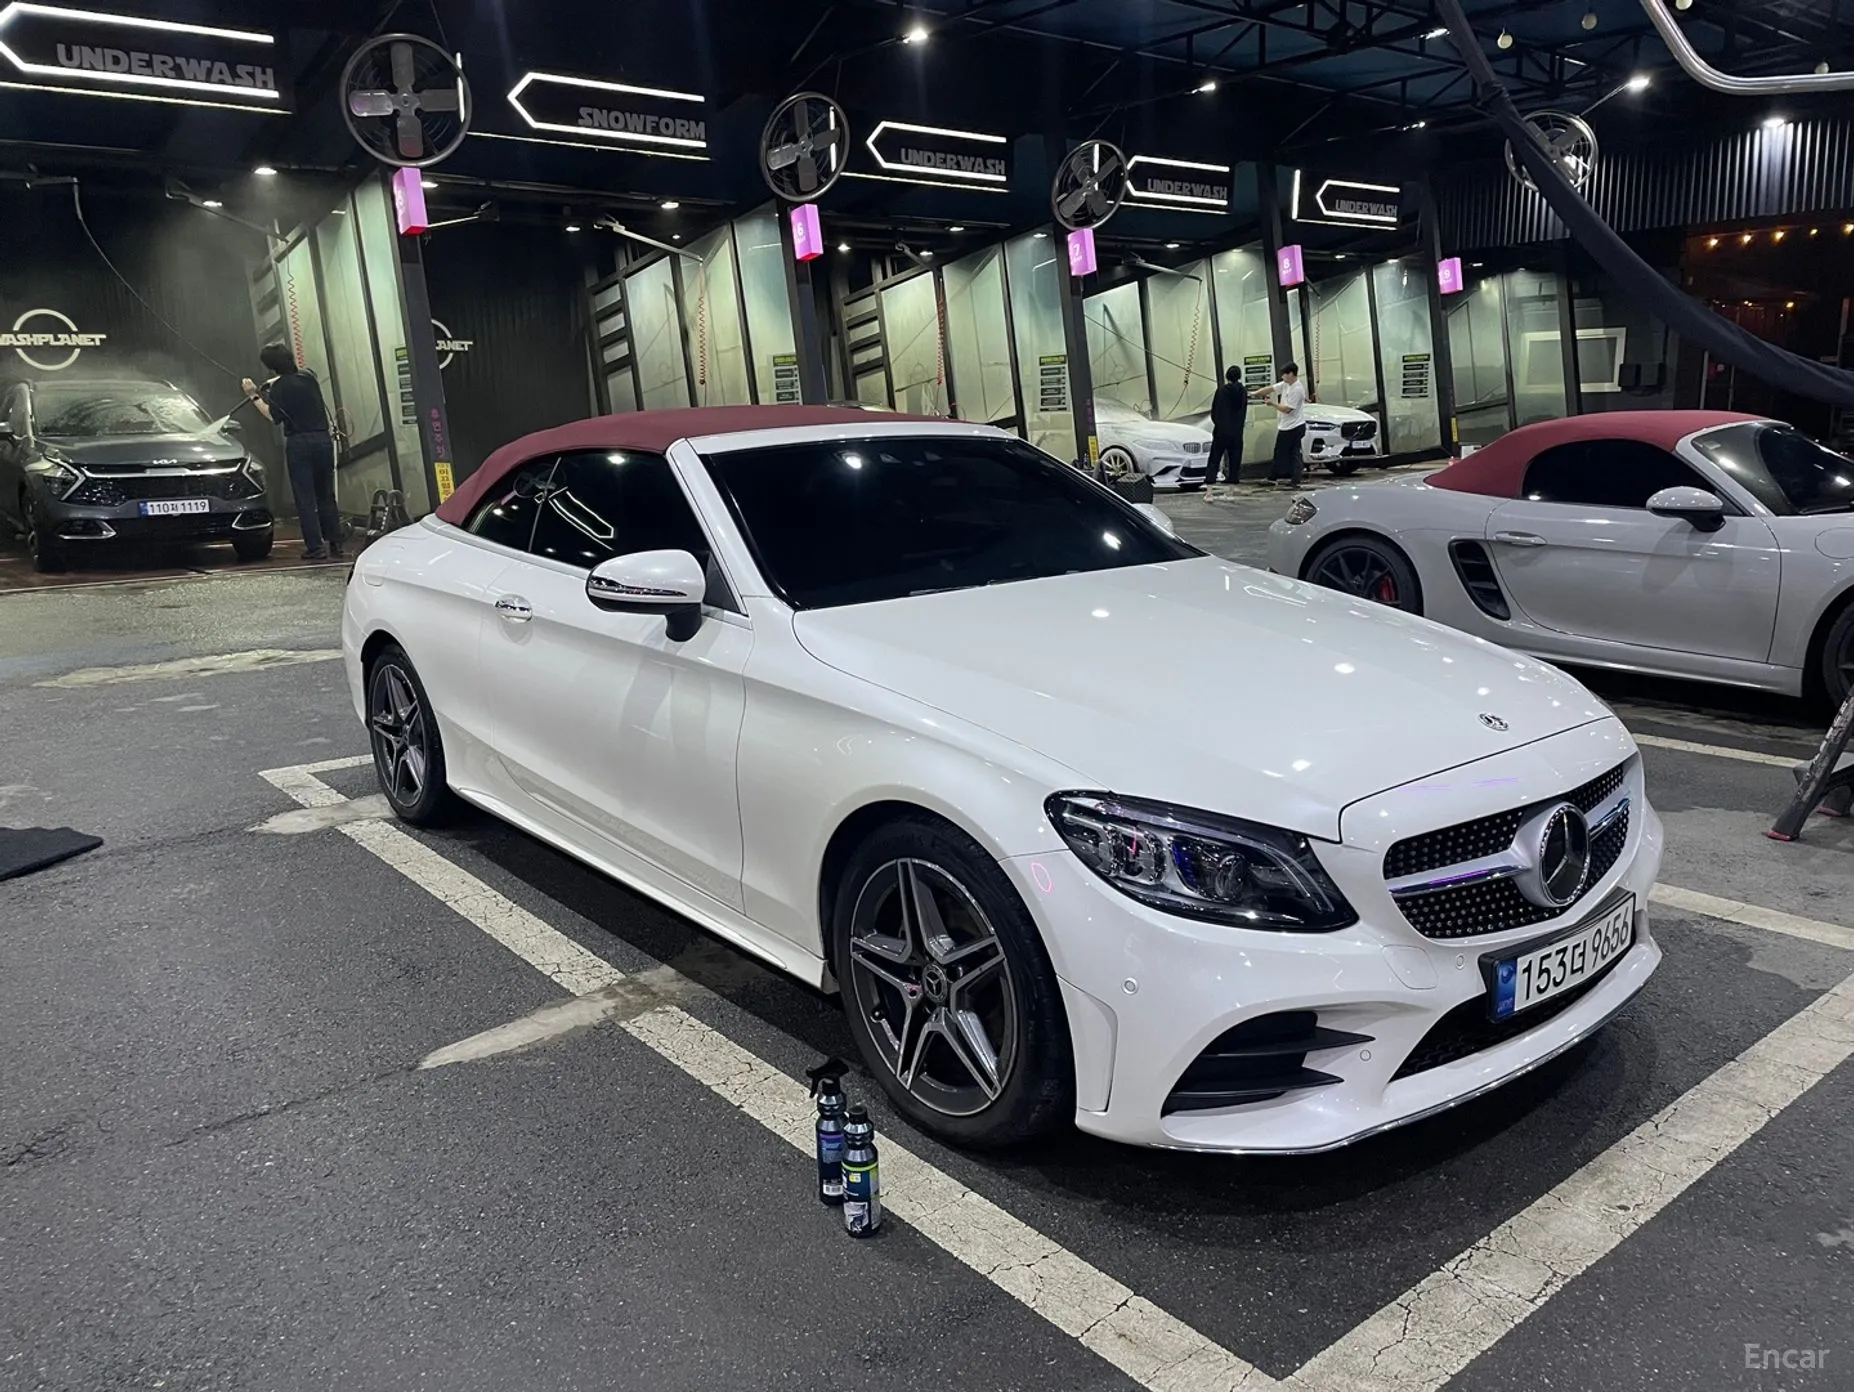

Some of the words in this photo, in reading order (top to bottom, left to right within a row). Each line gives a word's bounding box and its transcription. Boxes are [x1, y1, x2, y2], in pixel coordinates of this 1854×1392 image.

[56, 43, 275, 89] UNDERWASH
[578, 106, 706, 140] SNOWFORM
[900, 148, 1006, 175] UNDERWASH
[1147, 179, 1229, 201] UNDERWASH
[1335, 199, 1399, 218] UNDERWASH
[1073, 243, 1081, 257] 7
[1282, 257, 1290, 269] 8
[181, 501, 206, 511] 1119
[1522, 941, 1587, 999] 153더
[1592, 907, 1629, 968] 9656
